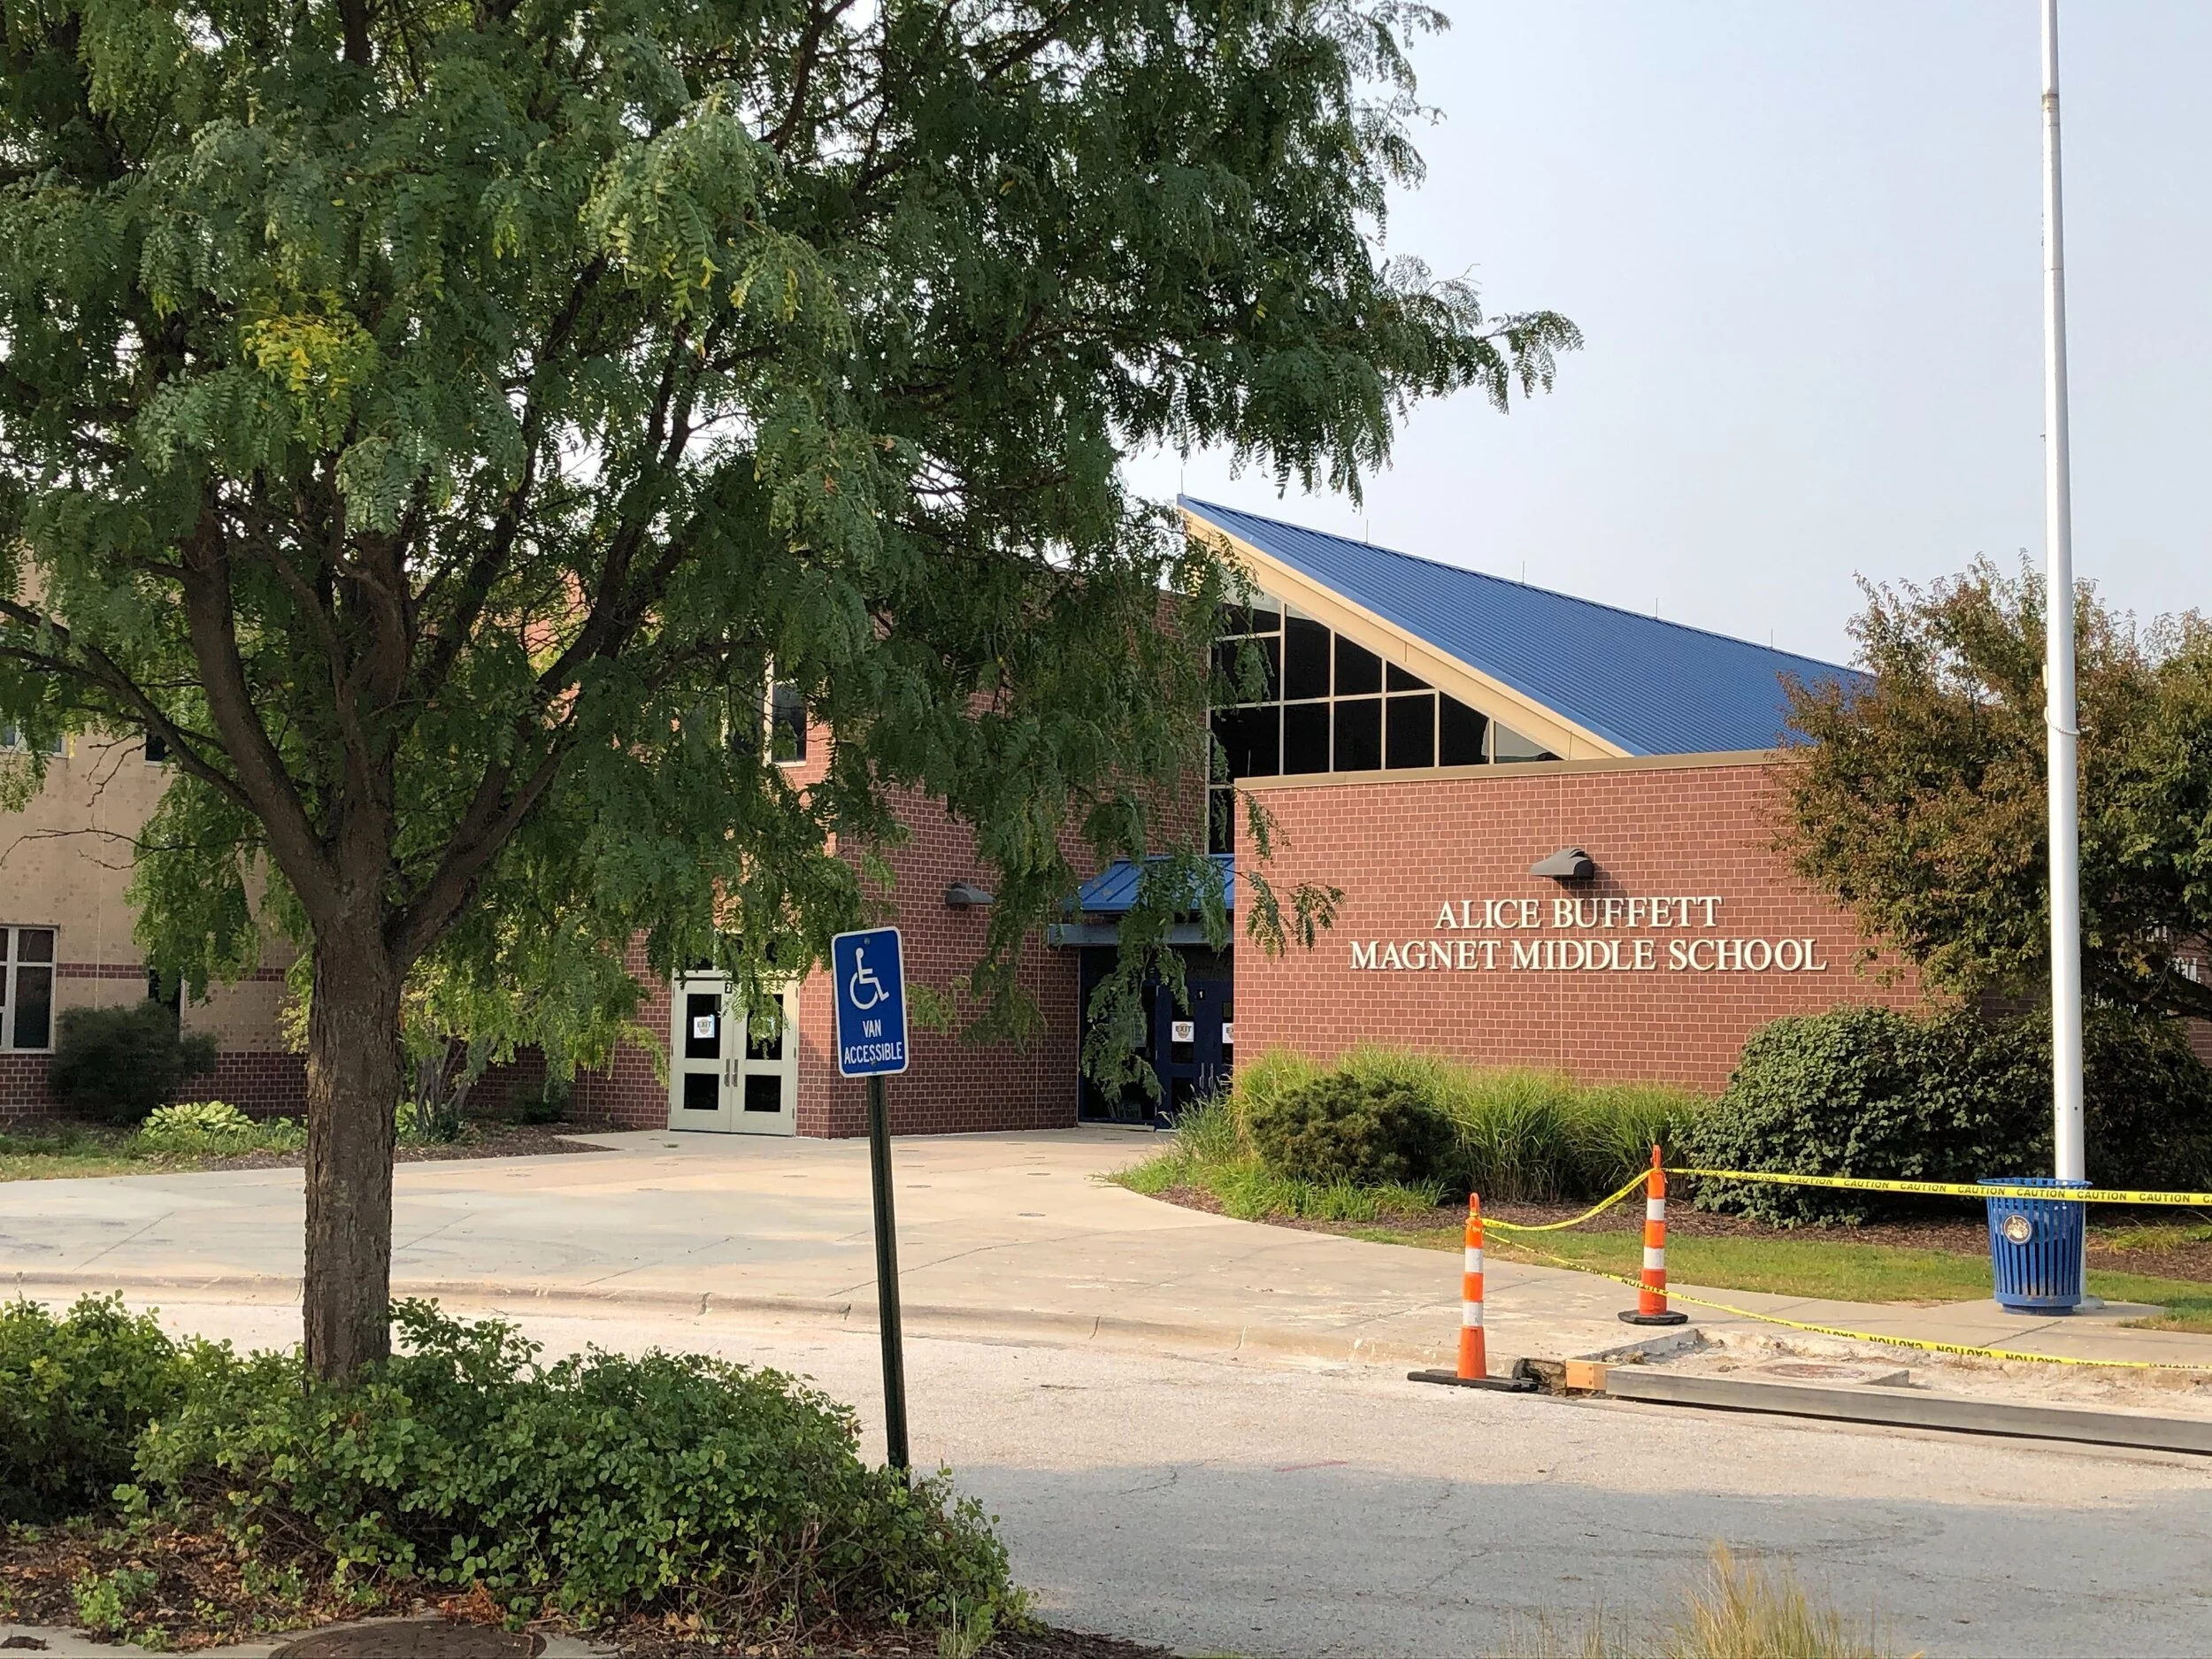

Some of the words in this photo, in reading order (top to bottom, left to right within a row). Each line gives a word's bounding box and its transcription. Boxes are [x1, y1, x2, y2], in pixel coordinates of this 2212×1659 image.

[1434, 900, 1541, 930] ALICE
[1553, 896, 1722, 929] BUFFETT
[1349, 941, 1502, 971] MAGNET
[1511, 940, 1657, 971] MIDDLE
[1670, 939, 1828, 972] SCHOOL
[863, 1019, 882, 1038] VAN
[844, 1041, 903, 1064] ACCESSIBLE
[1789, 1176, 1834, 1186] CAUTION
[1844, 1179, 1890, 1189] CAUTION
[1900, 1182, 1947, 1193] CAUTION
[1957, 1185, 2006, 1196] CAUTION
[2016, 1188, 2066, 1199] CAUTION
[2077, 1191, 2127, 1202] CAUTION
[2139, 1193, 2190, 1203] CAUTION
